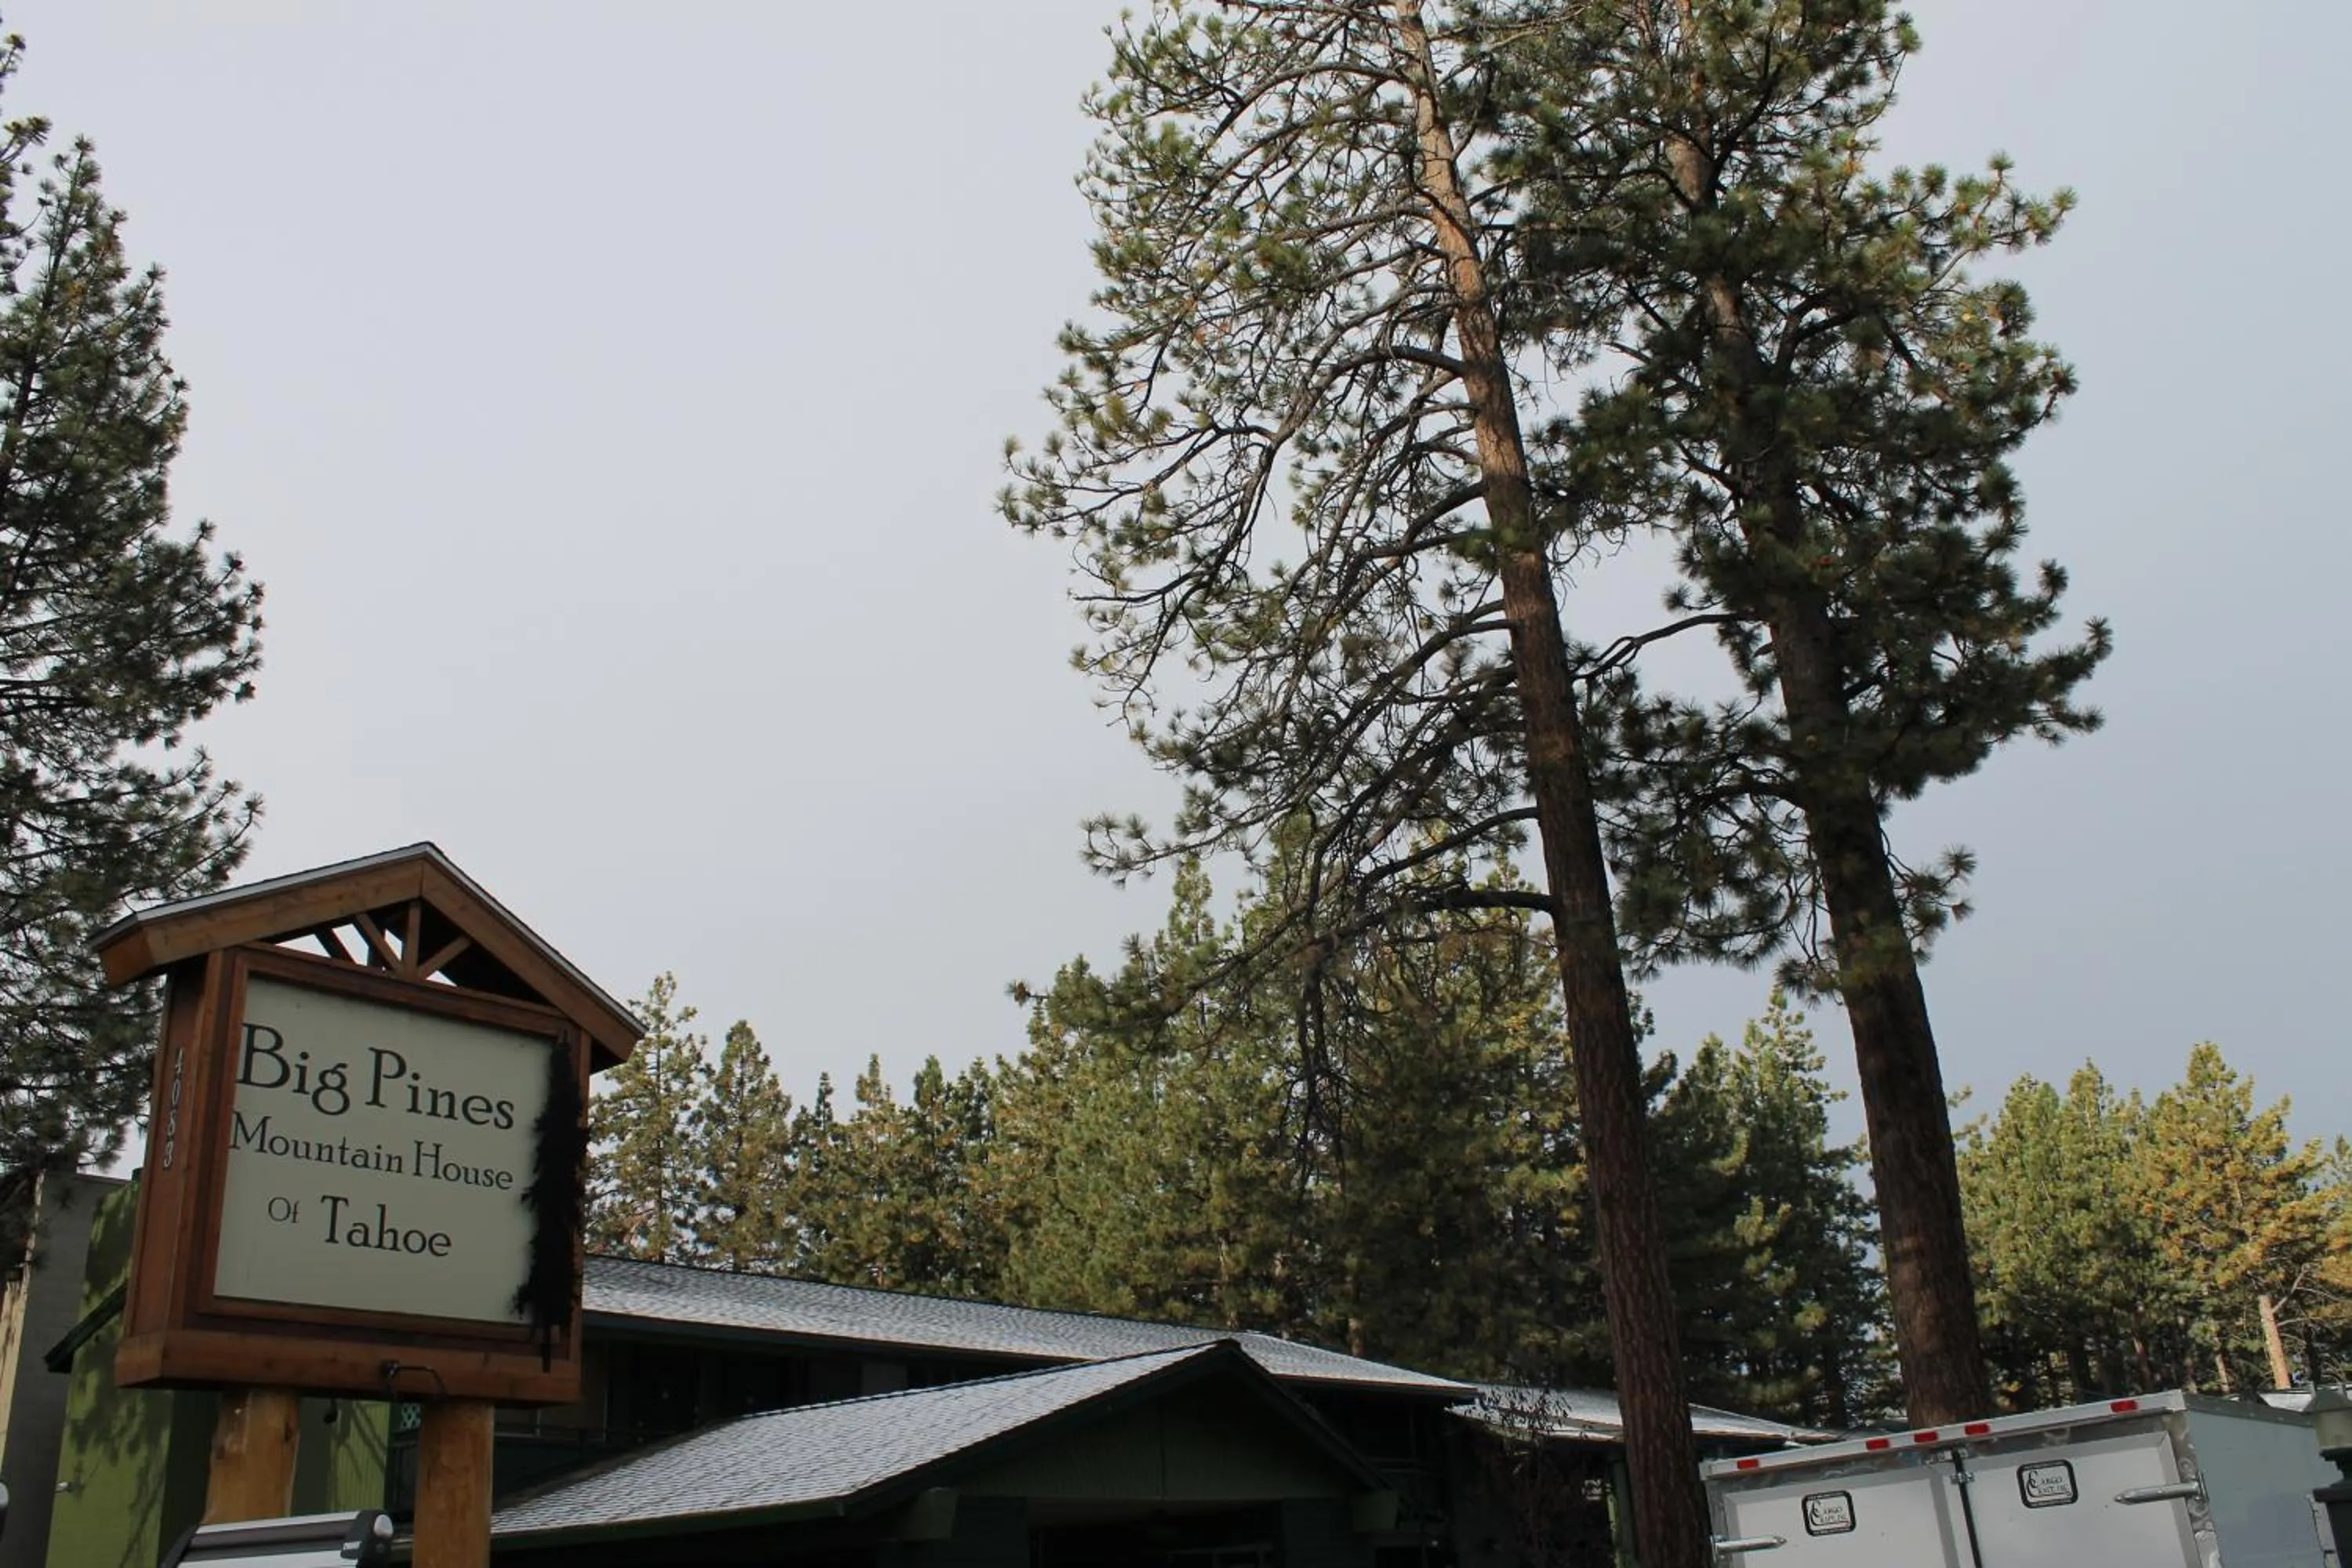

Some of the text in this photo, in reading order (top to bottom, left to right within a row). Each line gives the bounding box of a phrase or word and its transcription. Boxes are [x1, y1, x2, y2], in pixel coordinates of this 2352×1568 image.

[238, 1022, 514, 1130] Big Pines
[230, 1112, 514, 1190] Mountain House
[267, 1196, 452, 1257] Of Tahoe
